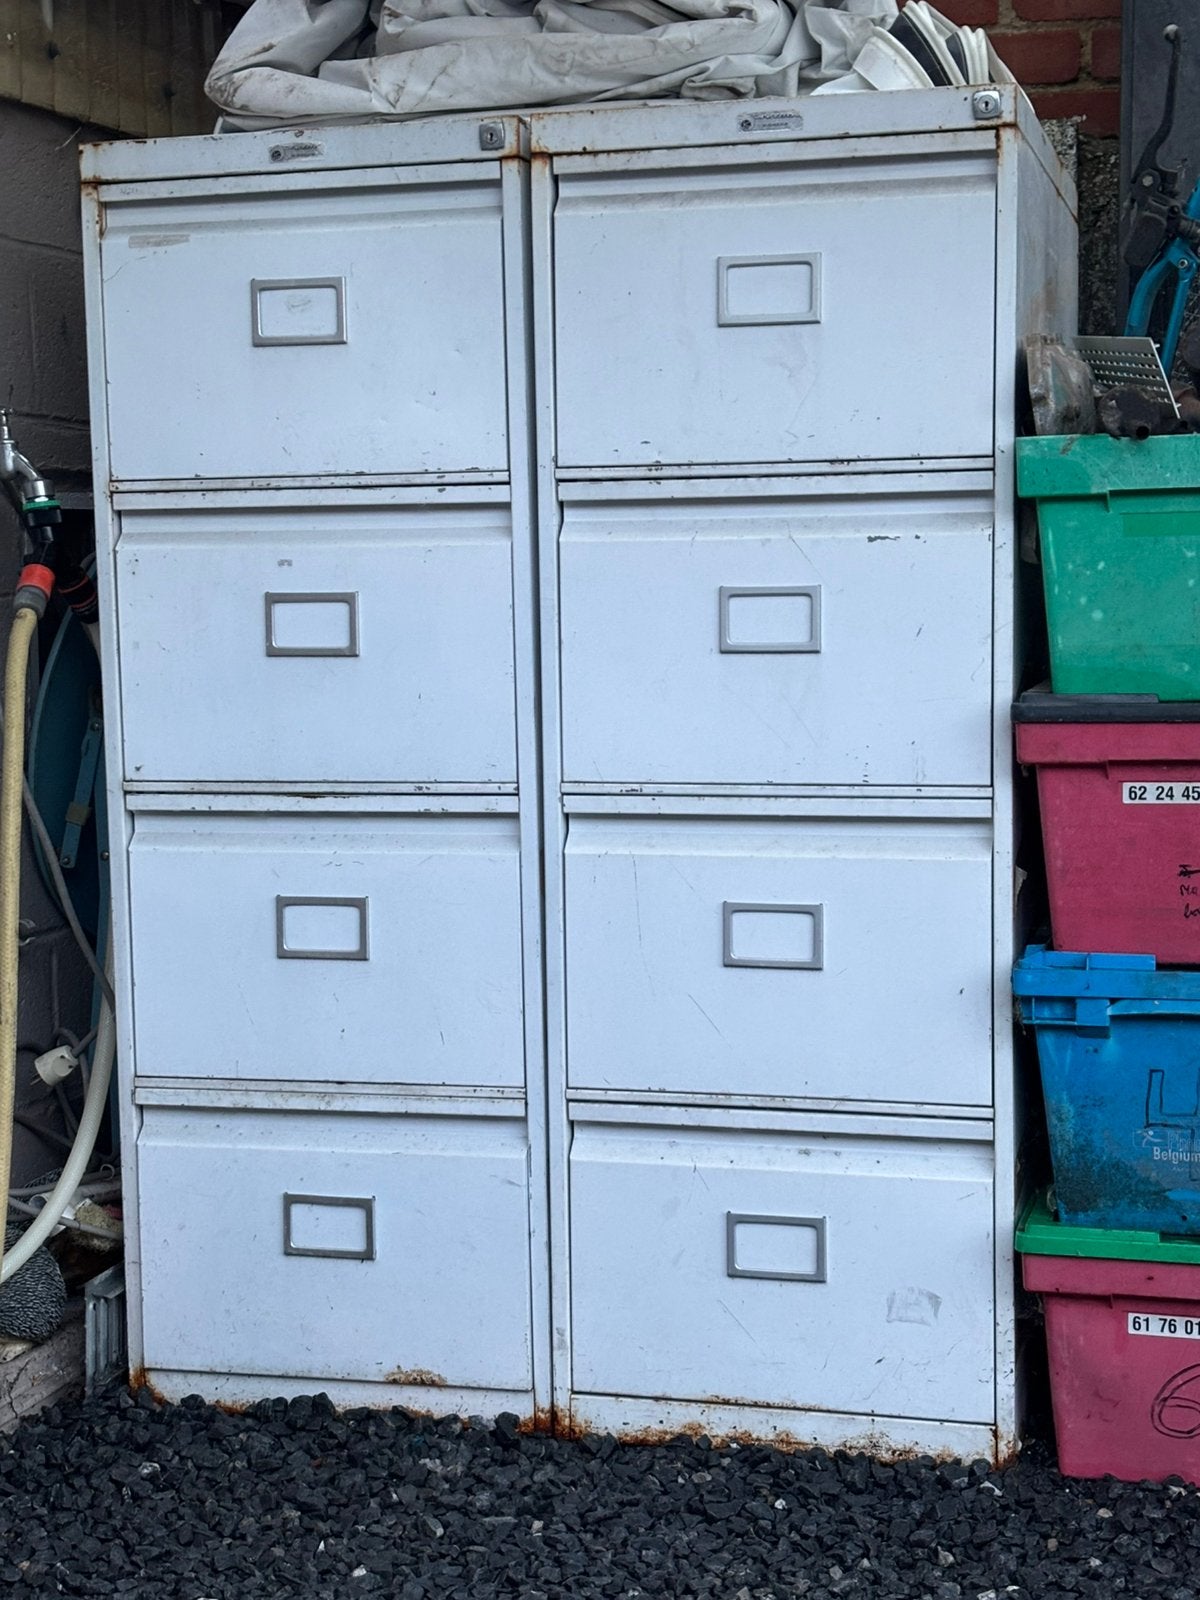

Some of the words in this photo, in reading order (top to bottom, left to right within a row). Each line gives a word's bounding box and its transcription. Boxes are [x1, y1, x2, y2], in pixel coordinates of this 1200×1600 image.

[1128, 785, 1147, 801] 62
[1155, 785, 1174, 801] 24
[1181, 785, 1200, 801] 45
[1153, 1146, 1200, 1164] Belgium
[1132, 1315, 1150, 1332] 61
[1158, 1317, 1177, 1334] 76
